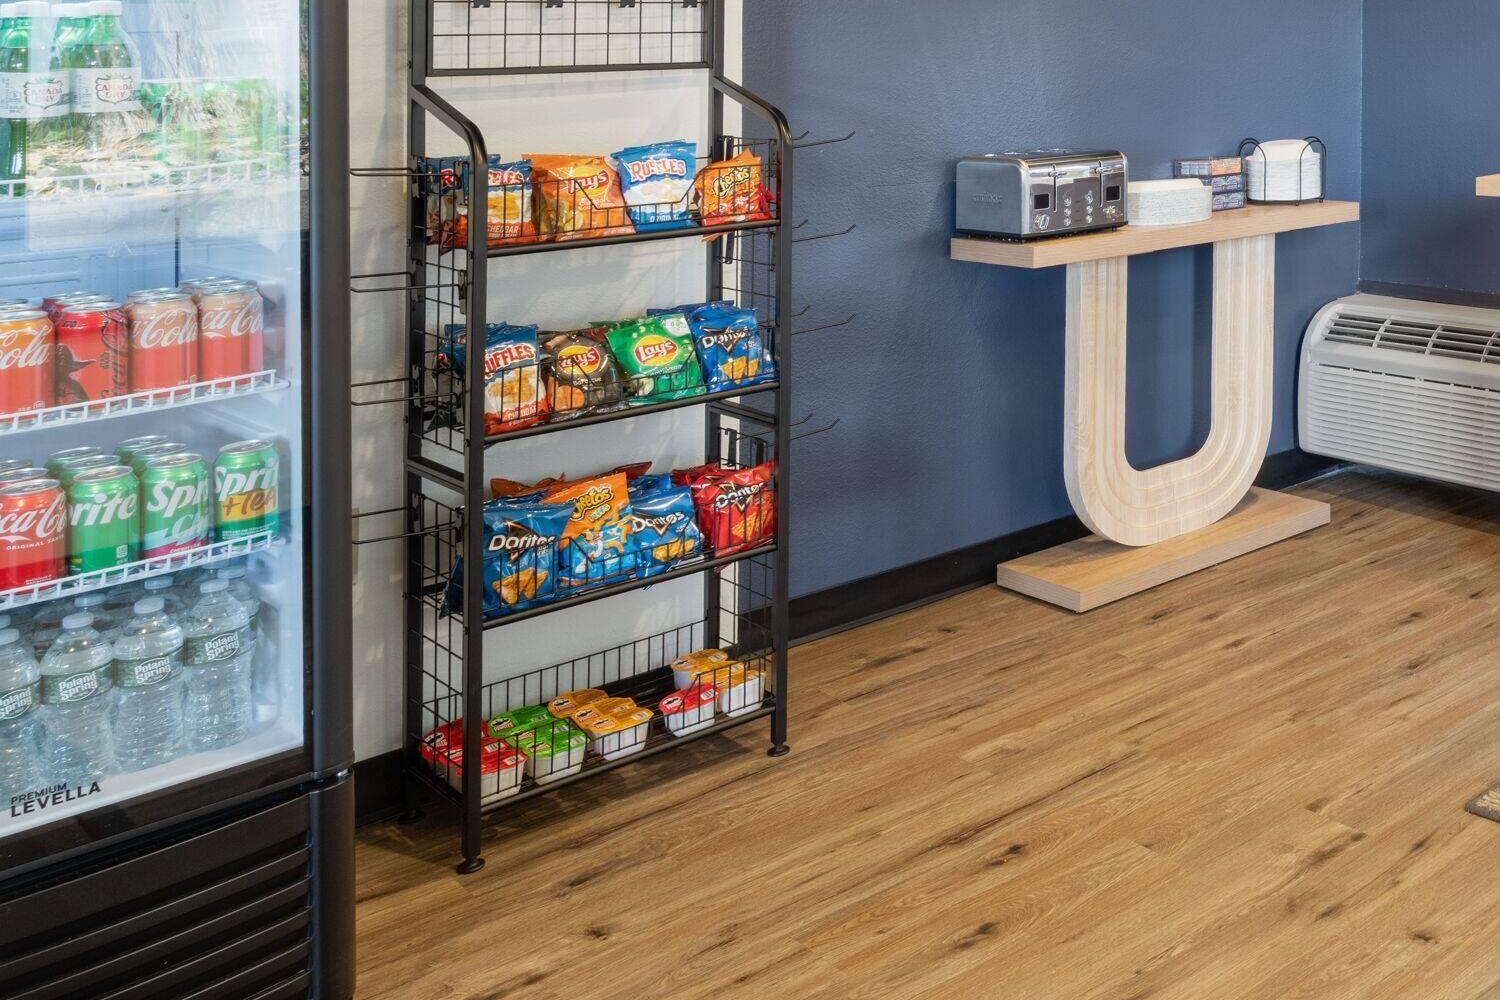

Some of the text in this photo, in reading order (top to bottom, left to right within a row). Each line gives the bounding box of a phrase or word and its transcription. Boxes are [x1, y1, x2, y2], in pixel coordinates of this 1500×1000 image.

[628, 158, 687, 182] RUFFLES
[639, 339, 676, 361] Lay's
[715, 481, 768, 510] Doritos
[632, 512, 685, 532] Doritos
[6, 541, 45, 551] ORIGINAL
[488, 533, 555, 551] Doritos
[205, 631, 239, 652] Poland
[206, 641, 240, 661] Spring
[134, 655, 170, 676] Poland
[136, 664, 171, 684] Spring
[59, 671, 97, 692] Poland
[60, 680, 98, 701] Spring
[10, 782, 67, 805] PREMIUM
[11, 781, 101, 818] LEVELLA
